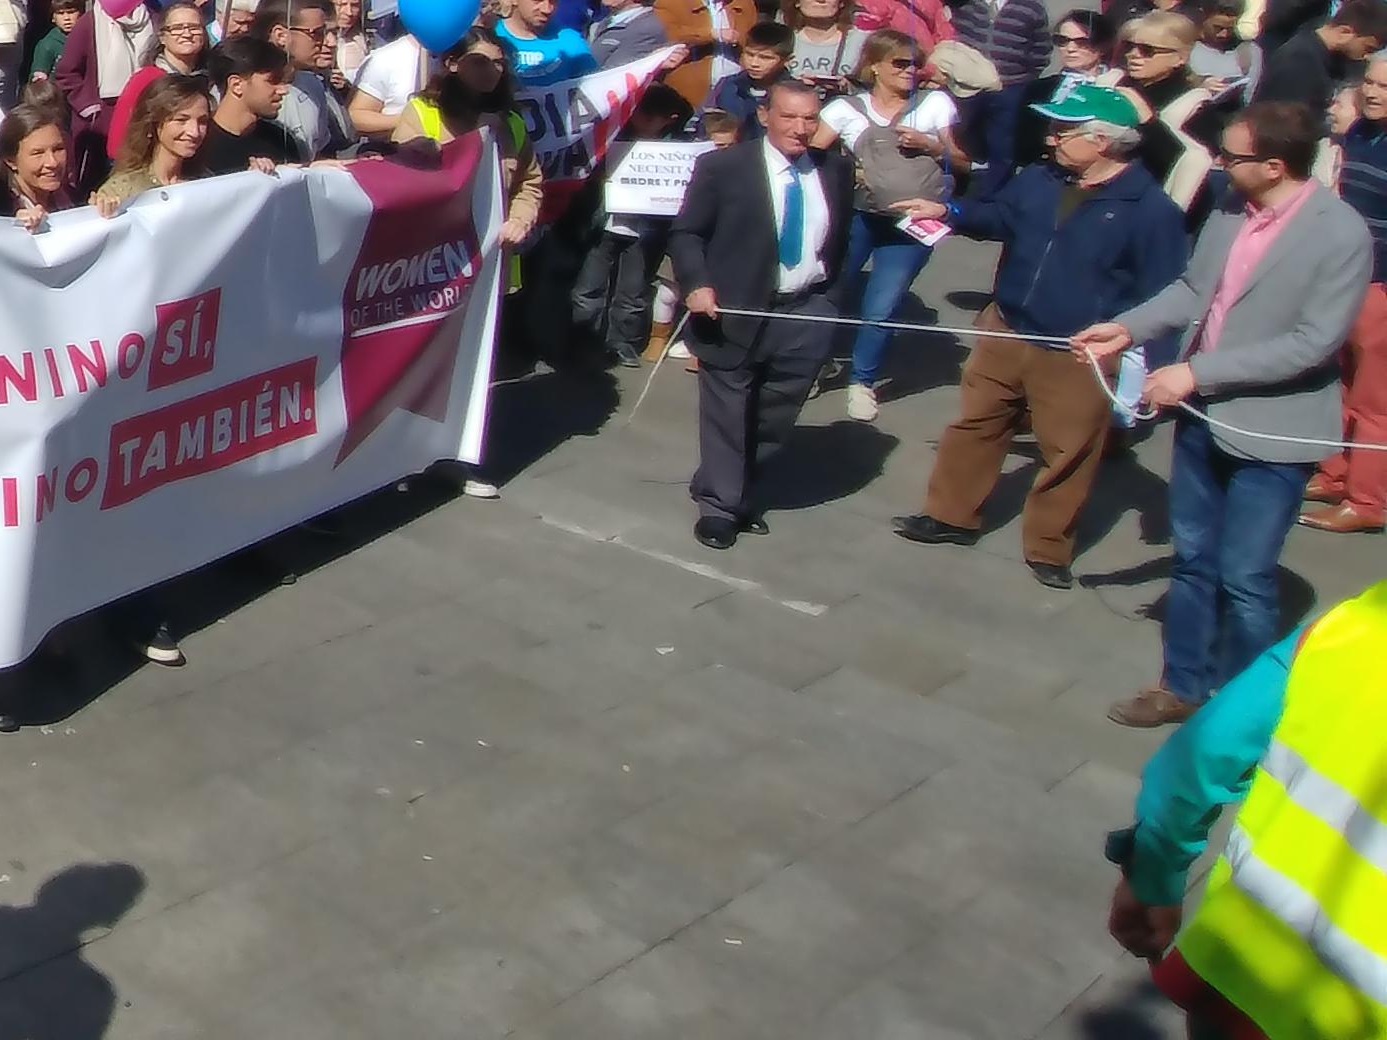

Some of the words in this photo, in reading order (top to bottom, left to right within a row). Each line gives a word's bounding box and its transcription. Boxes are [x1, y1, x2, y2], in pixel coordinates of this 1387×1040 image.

[789, 57, 851, 74] PARS
[630, 151, 655, 160] LOS
[620, 177, 661, 186] MADRE
[664, 178, 670, 186] Y
[355, 240, 472, 301] WOMEN
[351, 305, 371, 327] OF
[375, 297, 405, 318] THE
[162, 300, 212, 365] SÍ,
[119, 380, 312, 486] TAMBIÉN.
